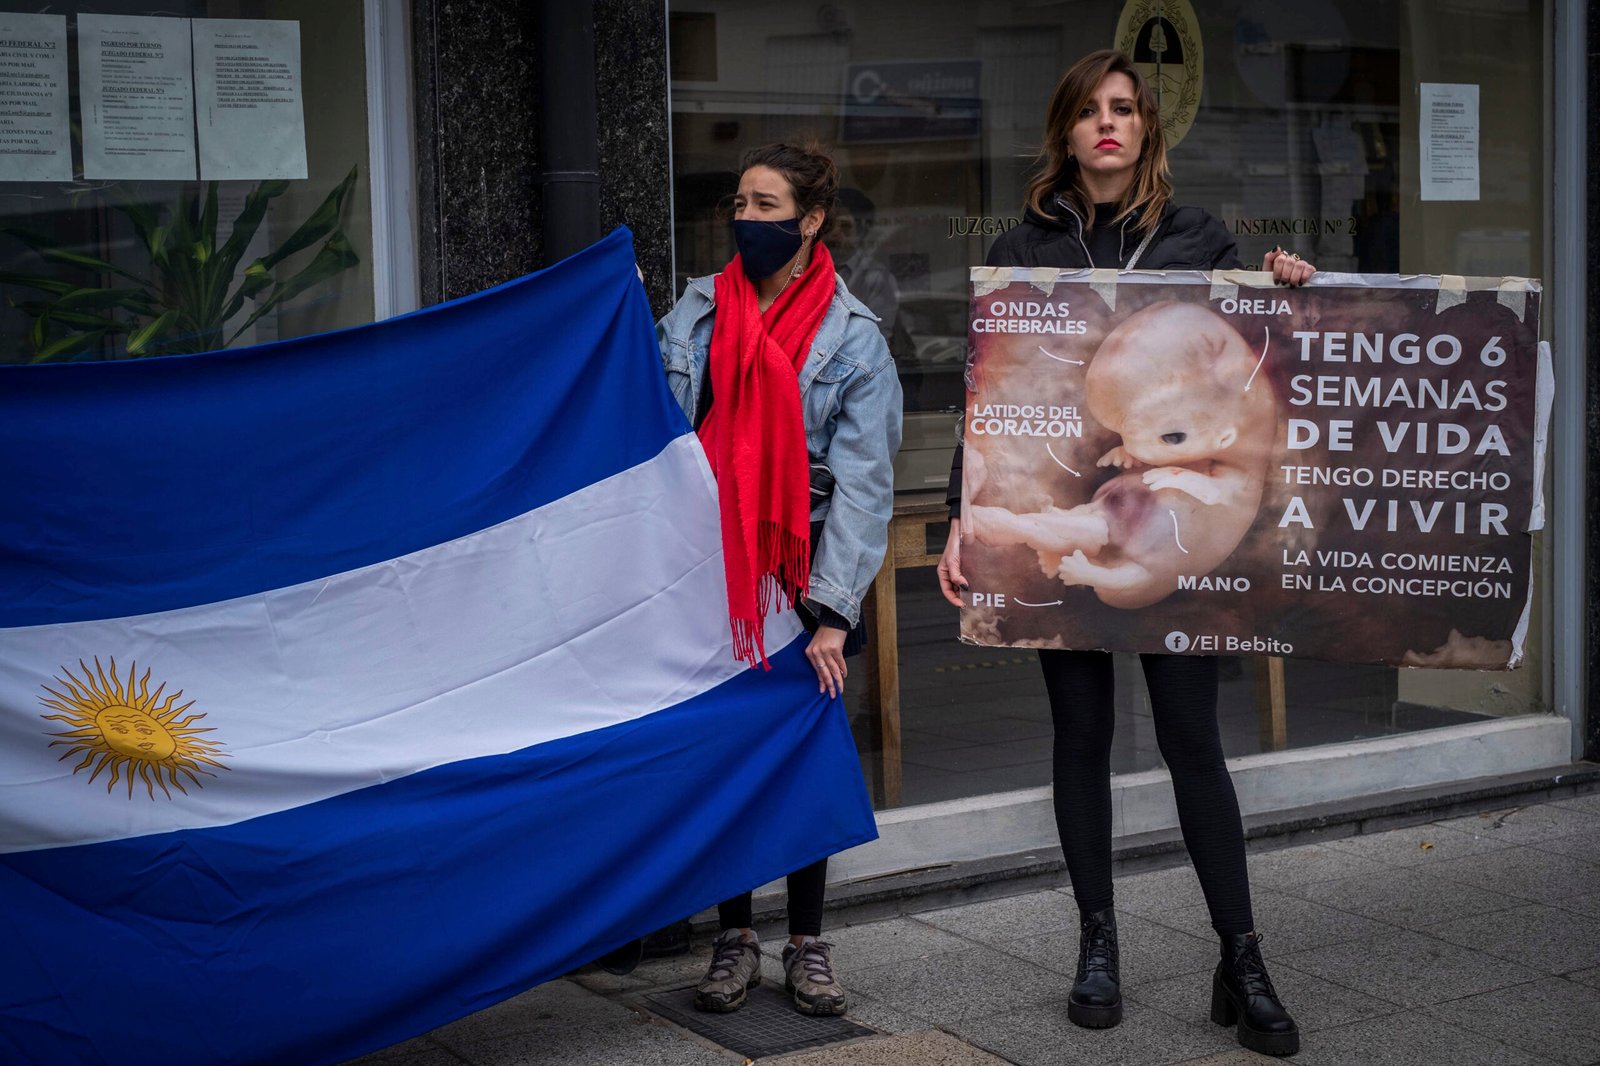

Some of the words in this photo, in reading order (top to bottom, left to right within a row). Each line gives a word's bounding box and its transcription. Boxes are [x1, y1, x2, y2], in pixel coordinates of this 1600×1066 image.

[9, 40, 42, 48] FEDERAL
[948, 216, 1020, 239] JUZGAD
[1235, 219, 1318, 235] INSTANCIA
[1348, 218, 1357, 235] 2
[990, 301, 1070, 318] ONDAS
[1220, 298, 1293, 316] OREJA
[972, 318, 1088, 336] CEREBRALES
[1292, 330, 1462, 366] TENGO
[1480, 336, 1507, 367] 6
[1288, 374, 1508, 412] SEMANAS
[973, 403, 1045, 420] LATIDOS
[1049, 406, 1082, 421] DEL
[970, 417, 1083, 438] CORAZÓN
[1287, 418, 1354, 452] DE
[1376, 421, 1511, 456] VIDA
[1281, 465, 1374, 487] TENGO
[1382, 469, 1511, 491] DERECHO
[1277, 496, 1314, 529] A
[1342, 498, 1509, 536] VIVIR
[1283, 549, 1311, 566] LA
[1316, 550, 1374, 569] VIDA
[1380, 552, 1513, 574] COMIENZA
[1177, 574, 1251, 592] MANO
[1281, 573, 1312, 590] EN
[1319, 575, 1347, 592] LA
[1352, 577, 1511, 599] CONCEPCIÓN
[972, 592, 1006, 608] PIE
[1226, 635, 1293, 654] Bebito
